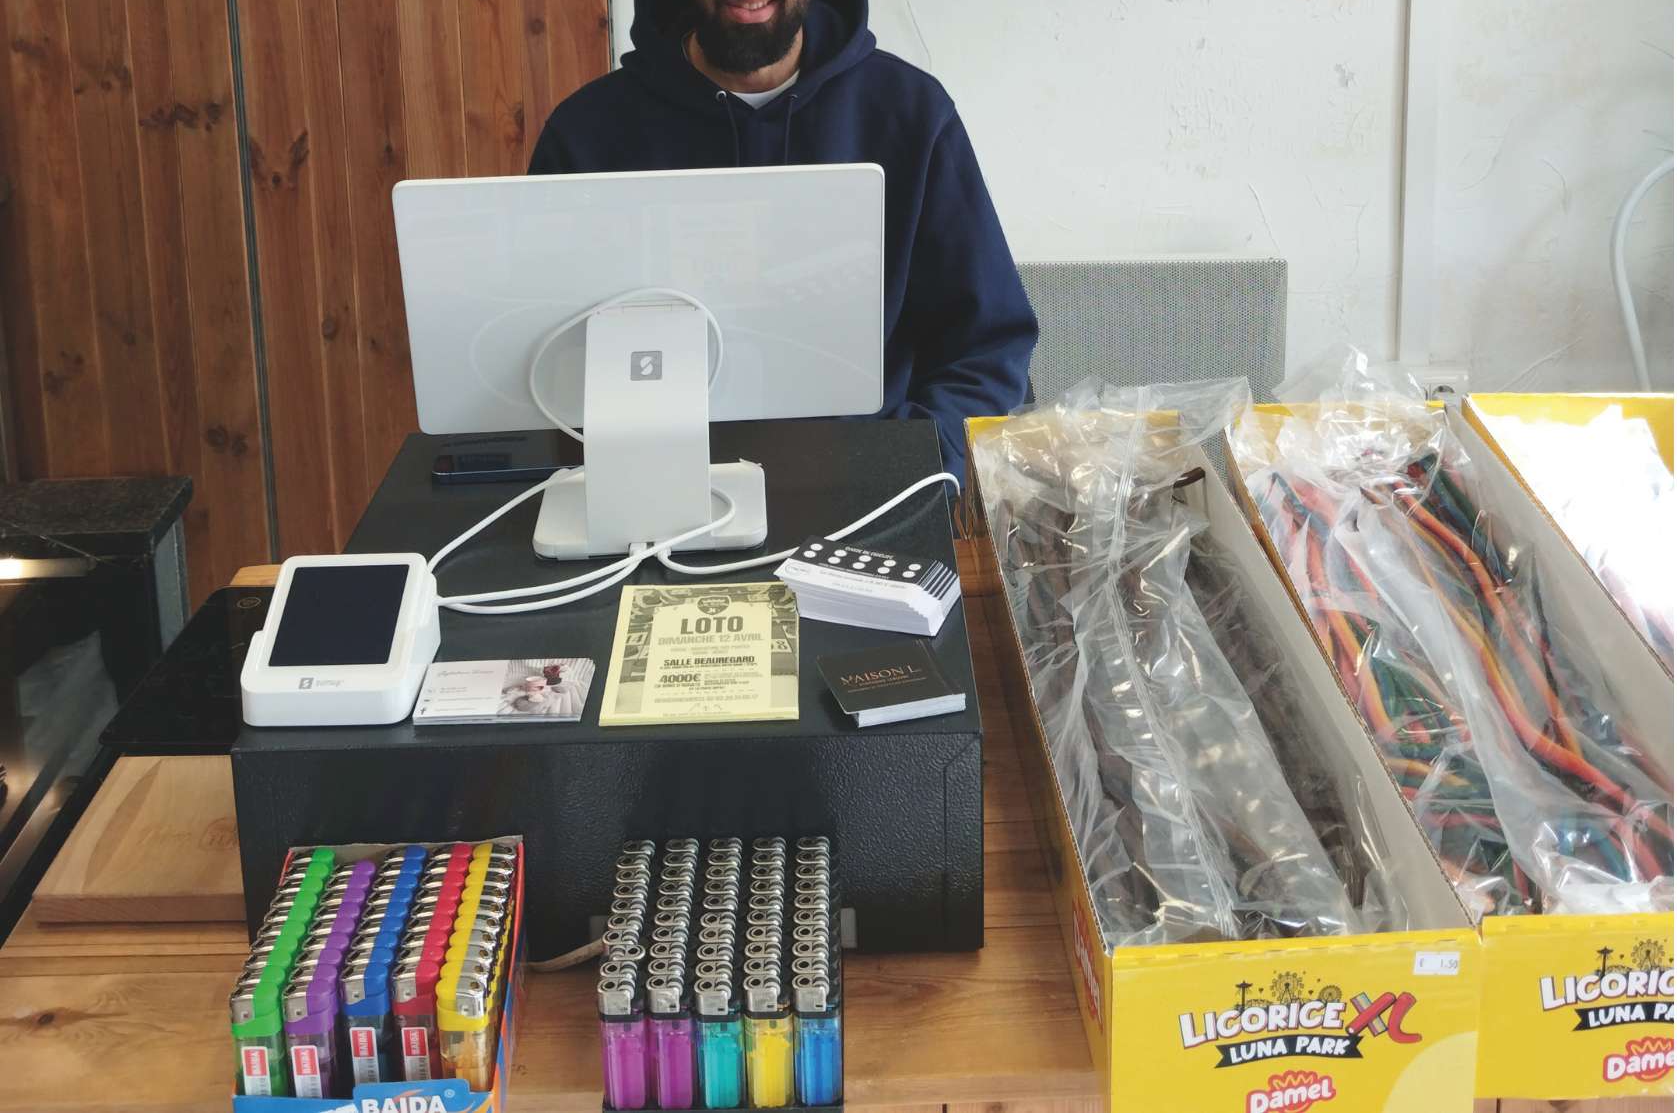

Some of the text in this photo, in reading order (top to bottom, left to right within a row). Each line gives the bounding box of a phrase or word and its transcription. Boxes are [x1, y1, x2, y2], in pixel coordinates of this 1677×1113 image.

[680, 616, 744, 635] LOTO
[658, 633, 763, 645] DIMANCHE 12 AVRIL
[664, 659, 692, 667] SALLE
[694, 656, 755, 665] BEAUREGARD
[659, 673, 702, 683] 4000€
[840, 667, 904, 686] MAISON
[1420, 958, 1458, 969] € 1.50
[1179, 992, 1422, 1049] LICORICE XL
[1588, 1004, 1645, 1028] LUNA
[359, 1031, 368, 1056] BAIDA
[412, 1031, 420, 1055] BAIDA
[1229, 1035, 1351, 1065] LUNA PARK
[252, 1051, 261, 1075] BAIDA
[302, 1050, 311, 1074] BAIDA
[361, 1095, 447, 1113] BAIDA
[1250, 1078, 1332, 1113] Damel
